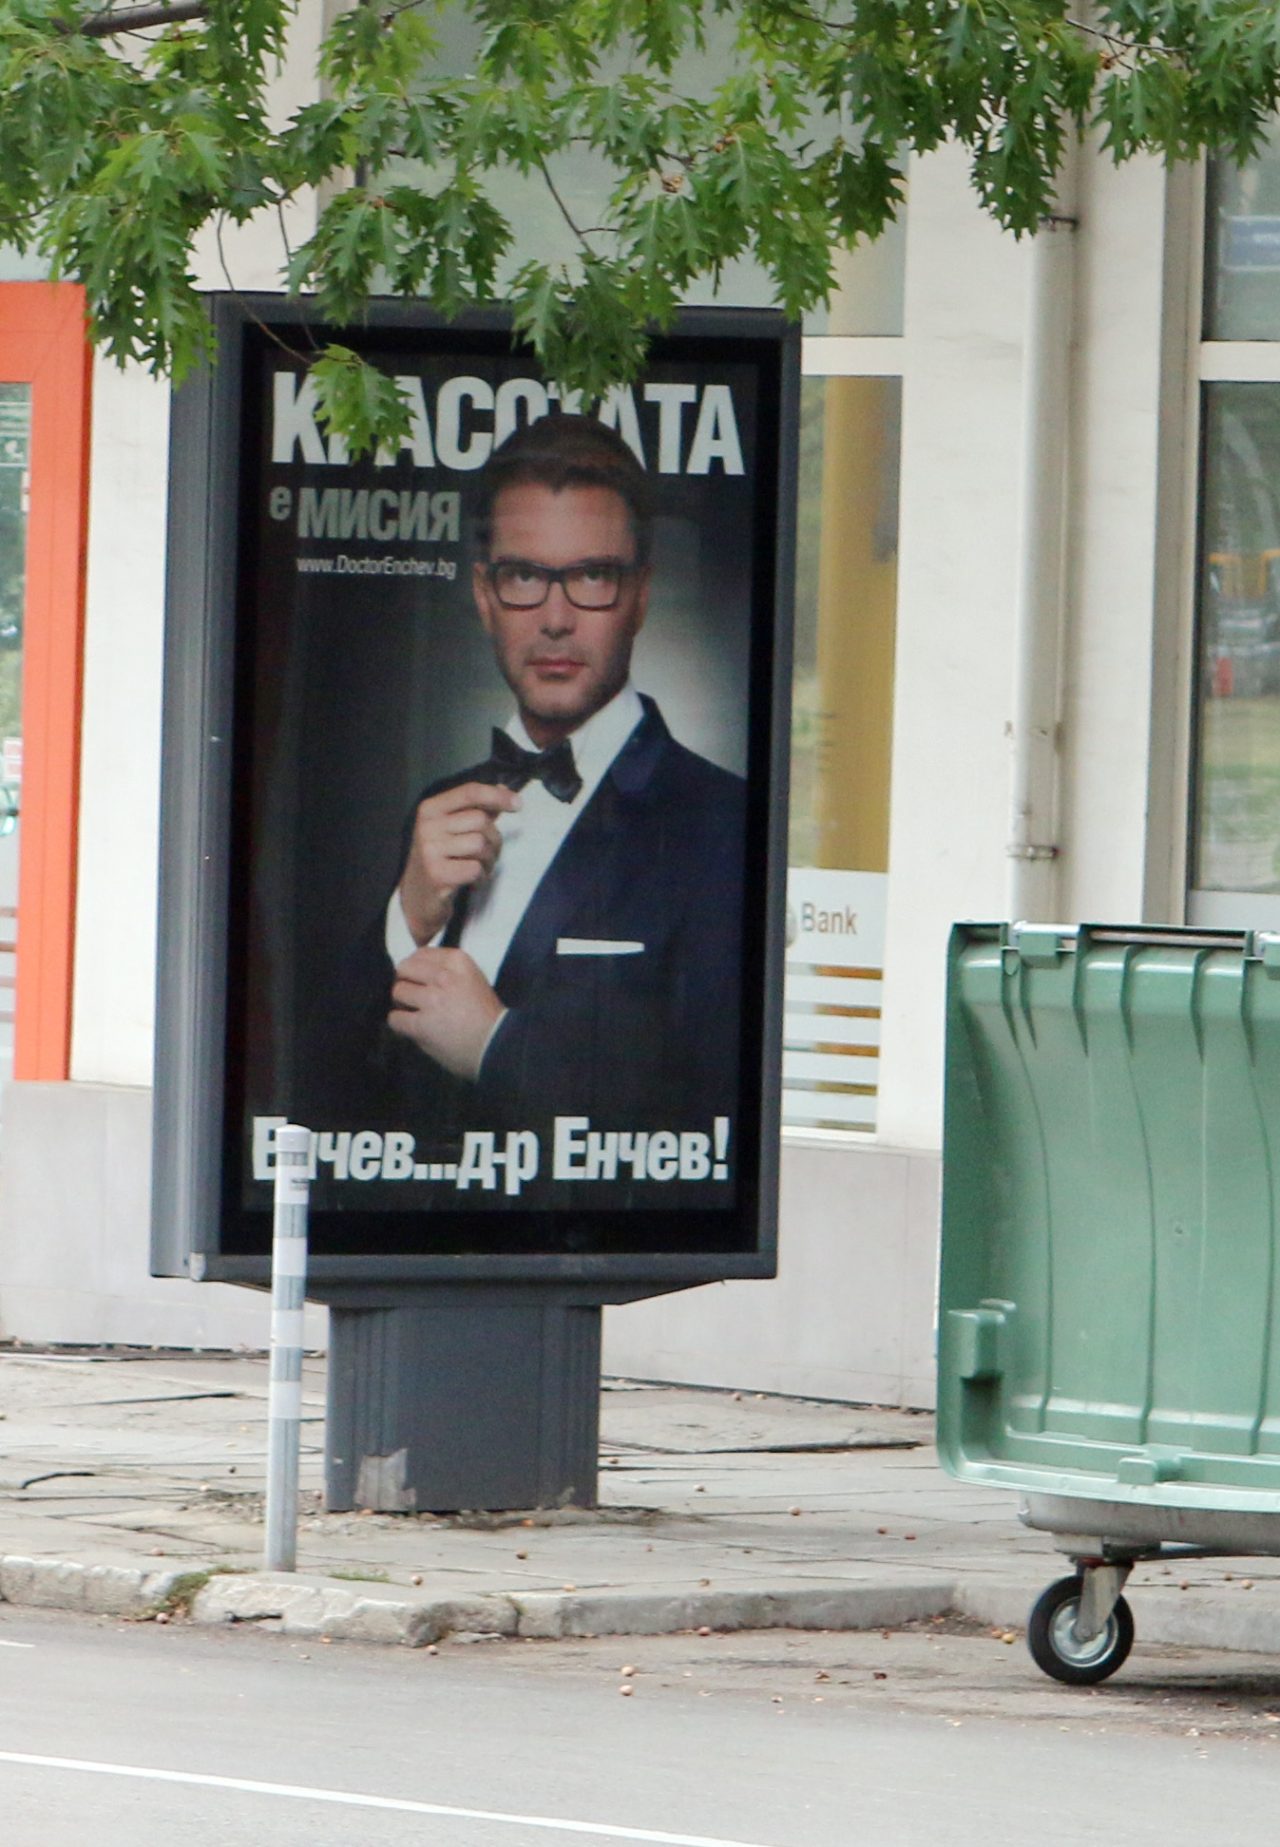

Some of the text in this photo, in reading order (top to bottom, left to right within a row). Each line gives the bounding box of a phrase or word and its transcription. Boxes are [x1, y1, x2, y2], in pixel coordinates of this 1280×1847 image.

[269, 485, 461, 542] е МИСИЯ
[296, 554, 458, 581] www.DoctorEnchev.bg
[801, 902, 859, 935] Bank
[553, 1115, 730, 1181] Енчев!
